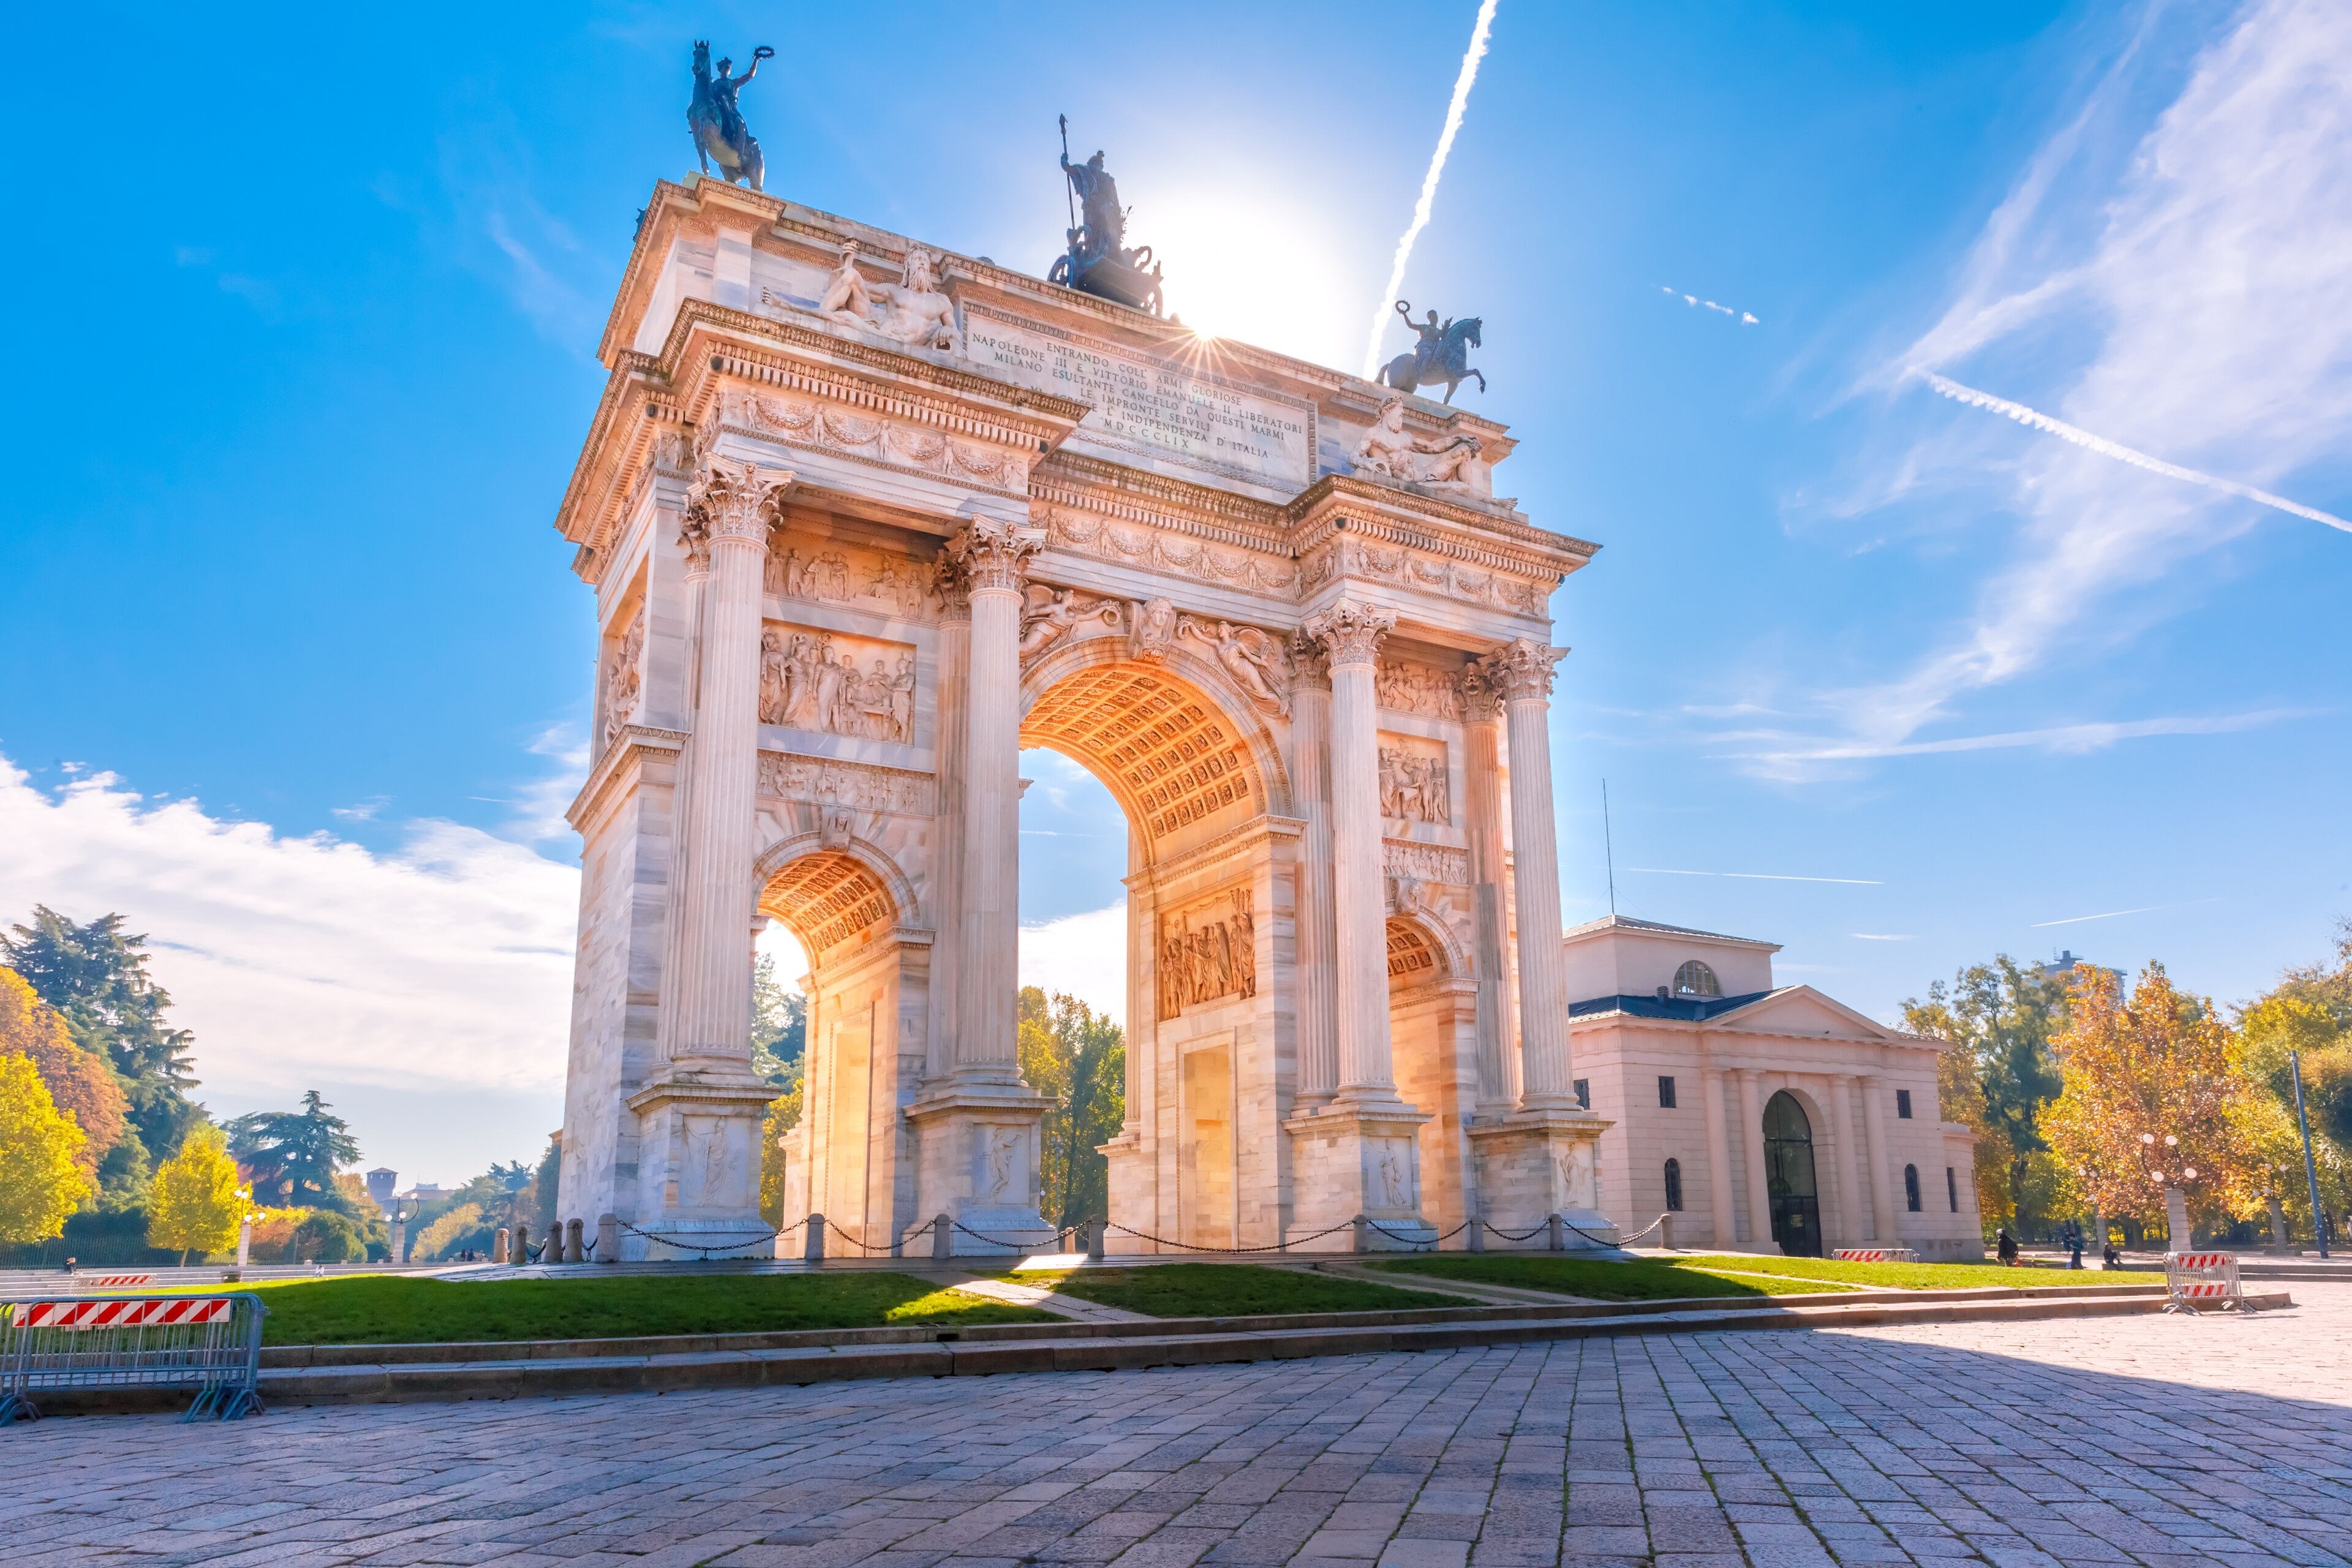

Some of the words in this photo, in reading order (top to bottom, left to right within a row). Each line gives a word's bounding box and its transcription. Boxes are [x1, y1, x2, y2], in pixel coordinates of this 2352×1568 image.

[973, 333, 1045, 362] NAPOLEONE
[1055, 357, 1067, 368] III
[1077, 363, 1083, 372] E
[1093, 367, 1147, 391] VITTORIO
[1156, 386, 1215, 410] EMANUELE
[1223, 405, 1231, 414] II
[1239, 409, 1302, 434] LIBERATORI
[995, 352, 1042, 372] MILANO
[1052, 369, 1115, 393] ESULTANTE
[1186, 406, 1199, 417] DA
[1207, 412, 1244, 429] QUESTI
[1251, 423, 1284, 441] MARMI
[1046, 342, 1109, 368] ENTRANDO
[1156, 375, 1183, 389] ARMI
[1191, 385, 1242, 406] GLORIOSE
[1080, 388, 1093, 398] LE
[1102, 394, 1160, 418] IMPRONTE
[1169, 413, 1210, 432] SERVILI
[1121, 411, 1208, 442] INDIPENDENZA
[1232, 442, 1268, 459] ITALIA
